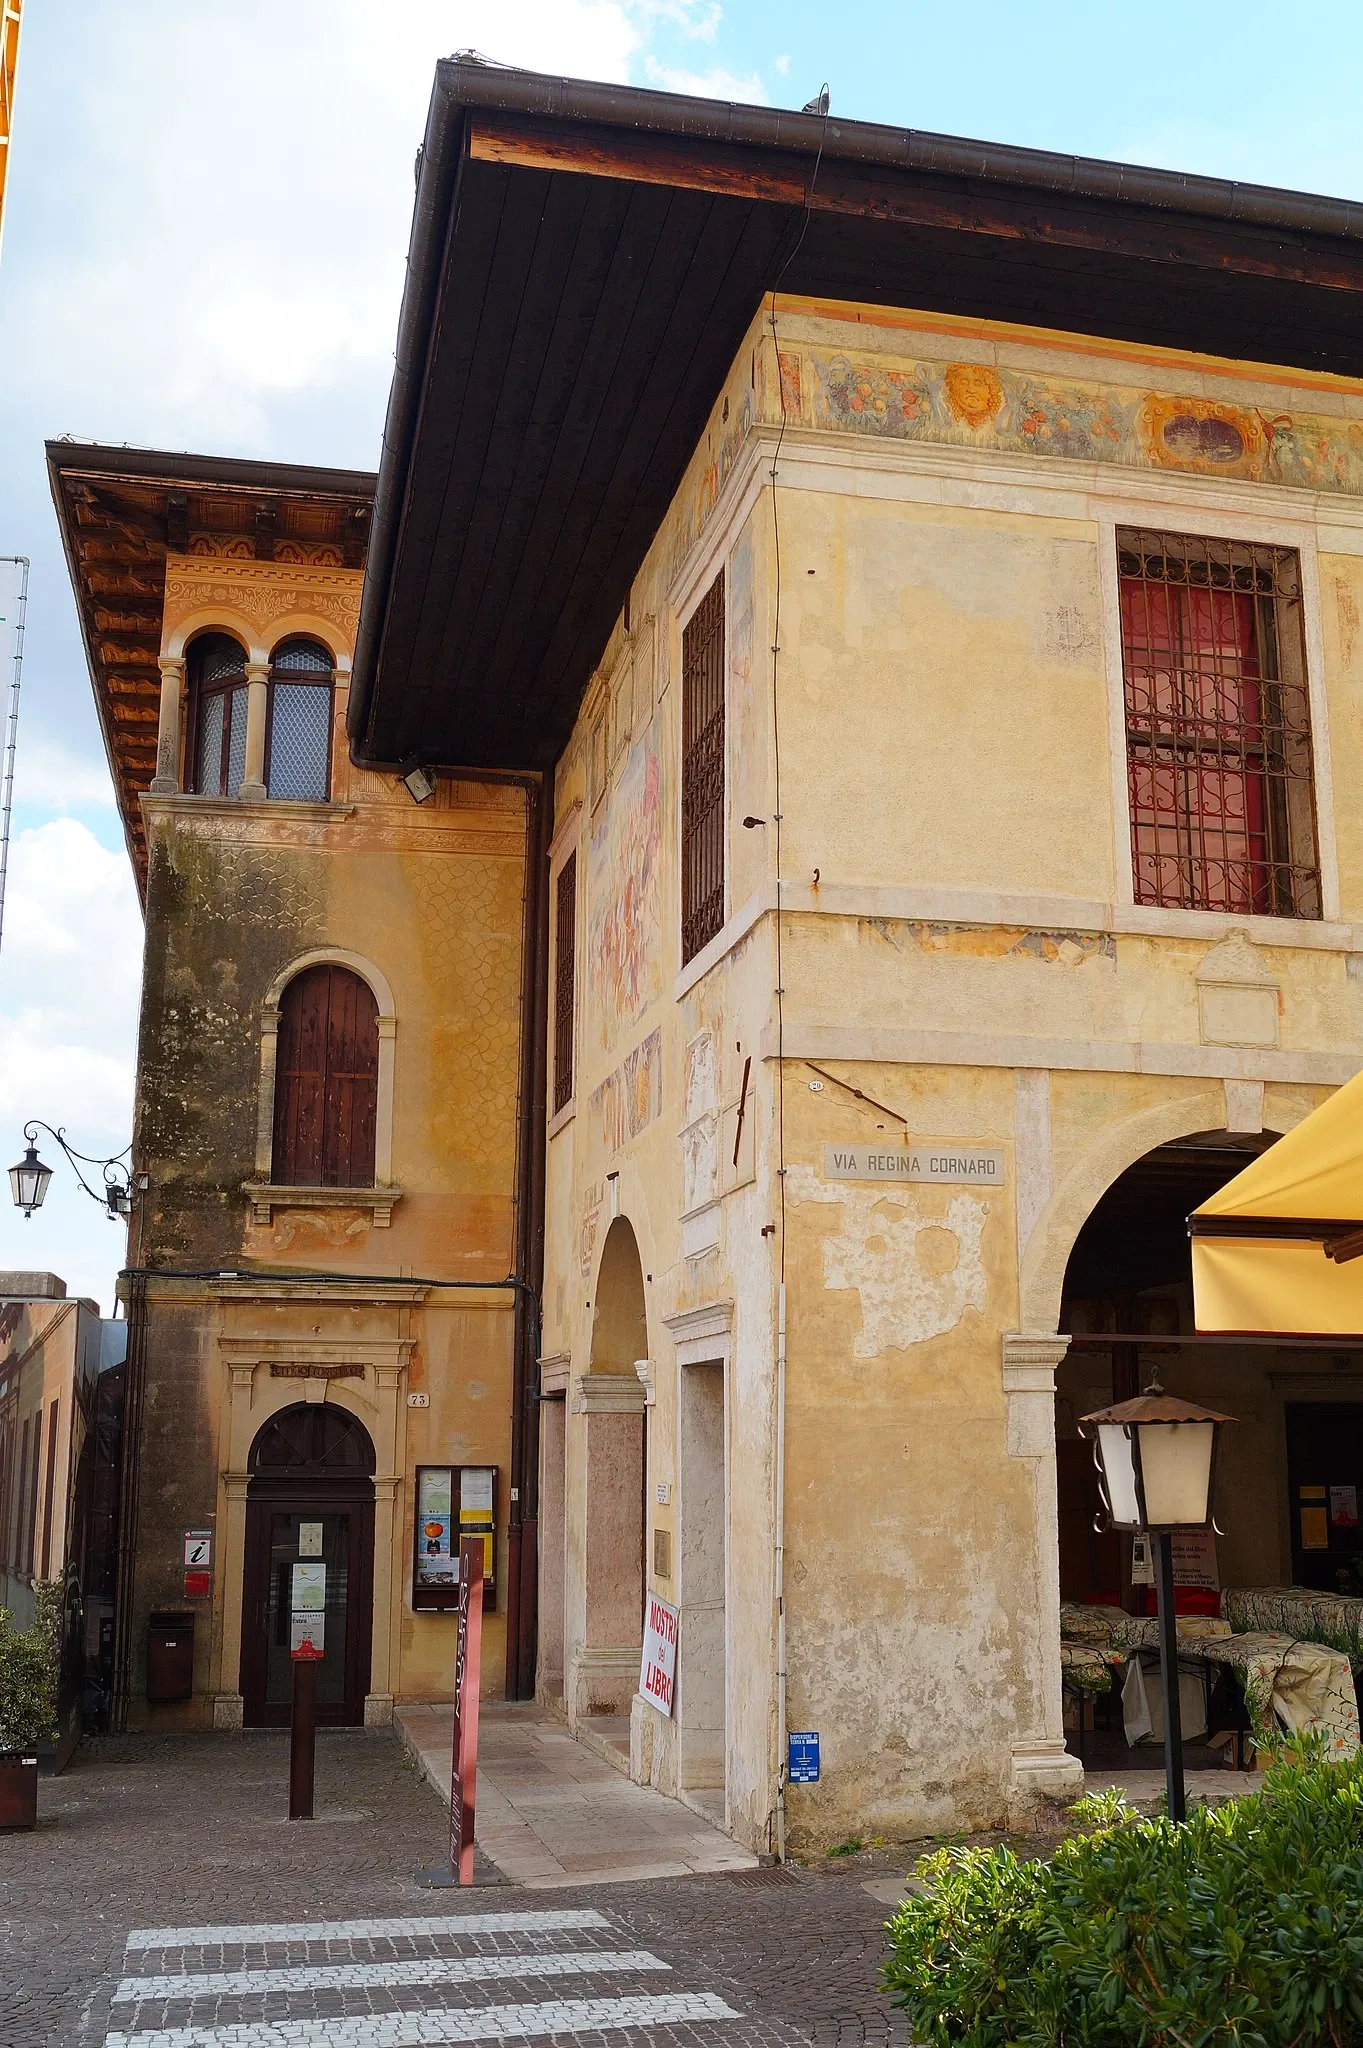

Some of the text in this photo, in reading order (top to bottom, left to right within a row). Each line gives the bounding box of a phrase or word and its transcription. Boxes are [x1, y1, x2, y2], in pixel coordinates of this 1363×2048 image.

[833, 1153, 996, 1175] VIA REGINA CORNARO
[412, 1395, 425, 1405] 73
[657, 1643, 667, 1663] del
